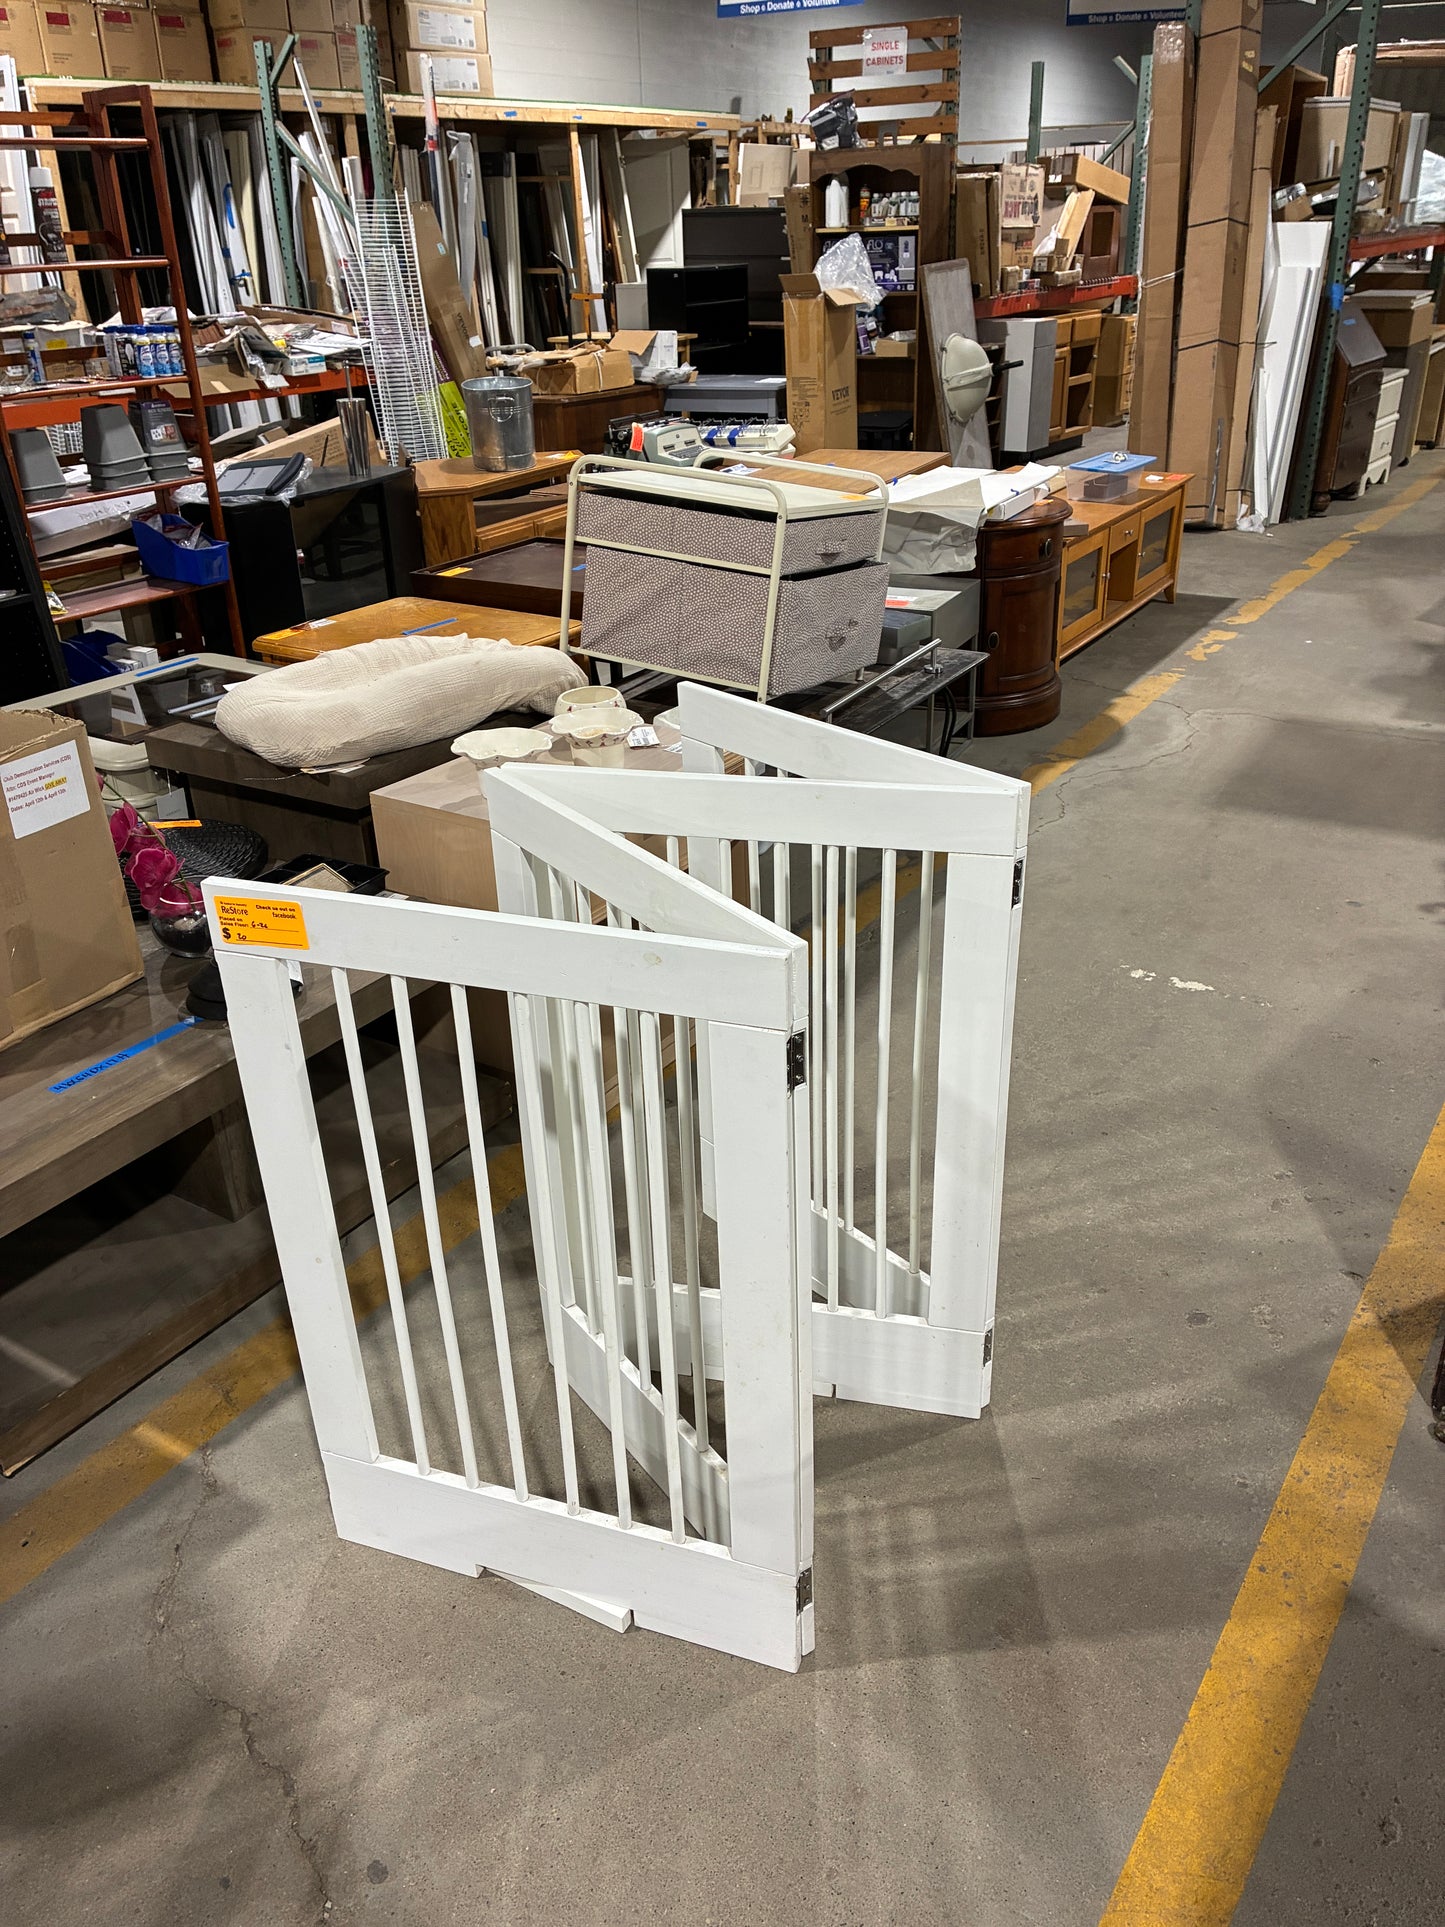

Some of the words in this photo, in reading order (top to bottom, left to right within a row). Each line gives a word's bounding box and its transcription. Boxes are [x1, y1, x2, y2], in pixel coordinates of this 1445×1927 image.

[740, 4, 760, 14] Shop
[767, 1, 794, 11] Donate
[871, 40, 900, 51] SINGLE
[865, 55, 904, 67] CABINETS
[832, 386, 850, 401] VEVOR
[14, 766, 43, 779] Demonstration
[43, 760, 60, 769] Services
[25, 800, 35, 808] April
[48, 791, 58, 800] April
[220, 905, 249, 915] ReStore
[222, 927, 232, 940] $
